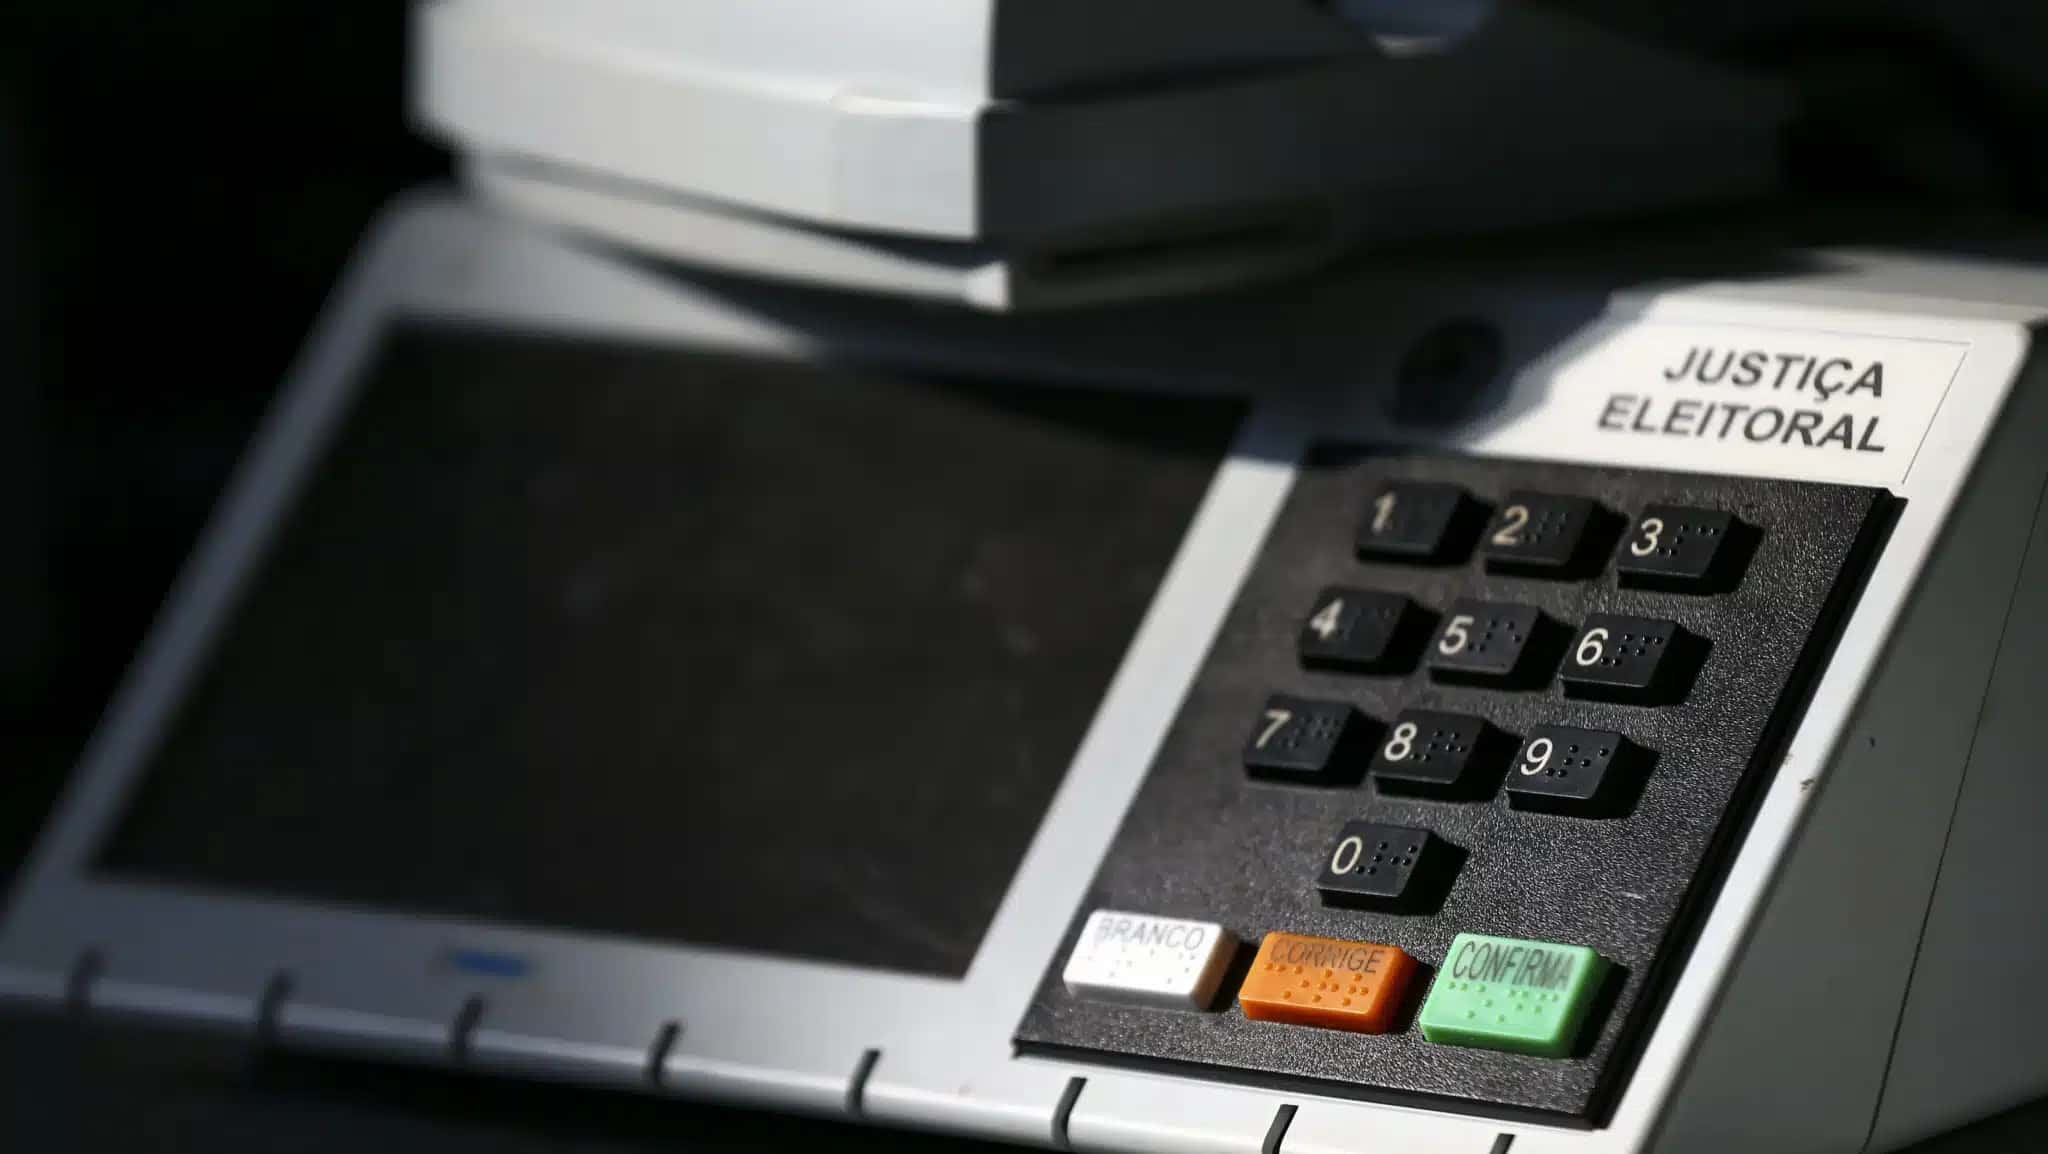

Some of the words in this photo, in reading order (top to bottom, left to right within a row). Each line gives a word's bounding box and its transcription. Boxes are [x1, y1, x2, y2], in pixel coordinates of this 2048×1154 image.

[1664, 347, 1884, 401] JUSTIÇA
[1597, 393, 1886, 453] ELEITORAL
[1372, 492, 1396, 532] 1
[1491, 506, 1528, 544] 2
[1630, 518, 1664, 556] 3
[1310, 600, 1342, 638] 4
[1439, 615, 1474, 655] 5
[1575, 627, 1608, 666] 6
[1255, 711, 1290, 748] 7
[1383, 722, 1418, 761] 8
[1520, 738, 1553, 776] 9
[1331, 837, 1363, 875] 0
[1095, 917, 1205, 952] BRANCO
[1268, 938, 1384, 975] CORRIGE
[1453, 941, 1577, 987] CONFIRMA
